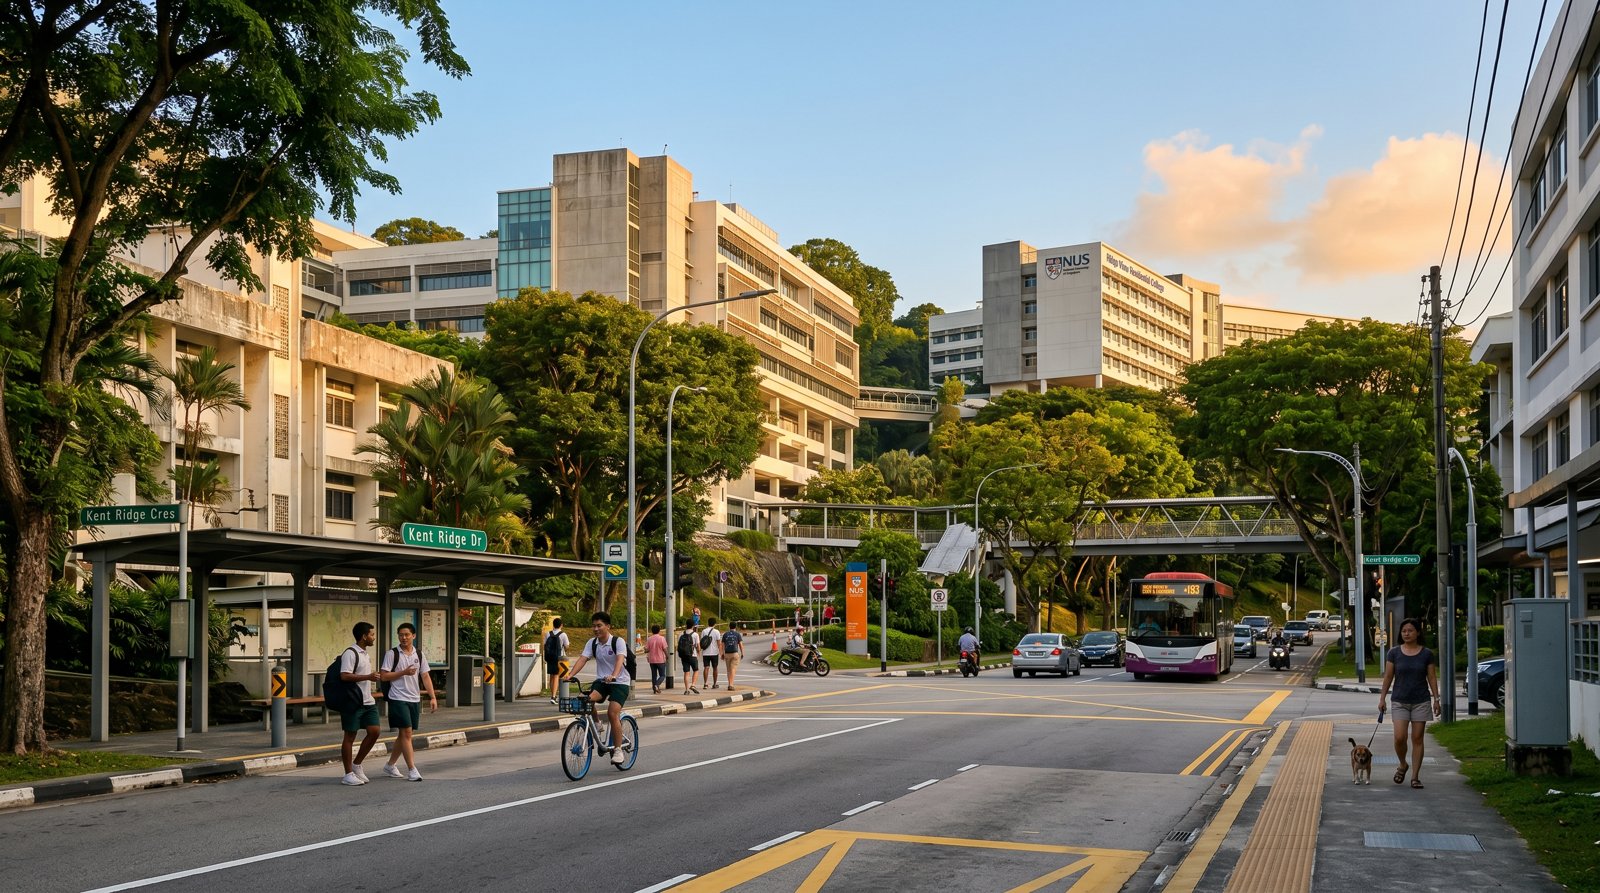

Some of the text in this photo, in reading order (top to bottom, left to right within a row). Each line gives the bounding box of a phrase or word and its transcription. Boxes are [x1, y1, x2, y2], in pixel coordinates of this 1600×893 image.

[1062, 253, 1090, 267] NUS
[87, 508, 175, 523] Kent Ridge Cres
[408, 527, 482, 549] Kent Ridge Dr
